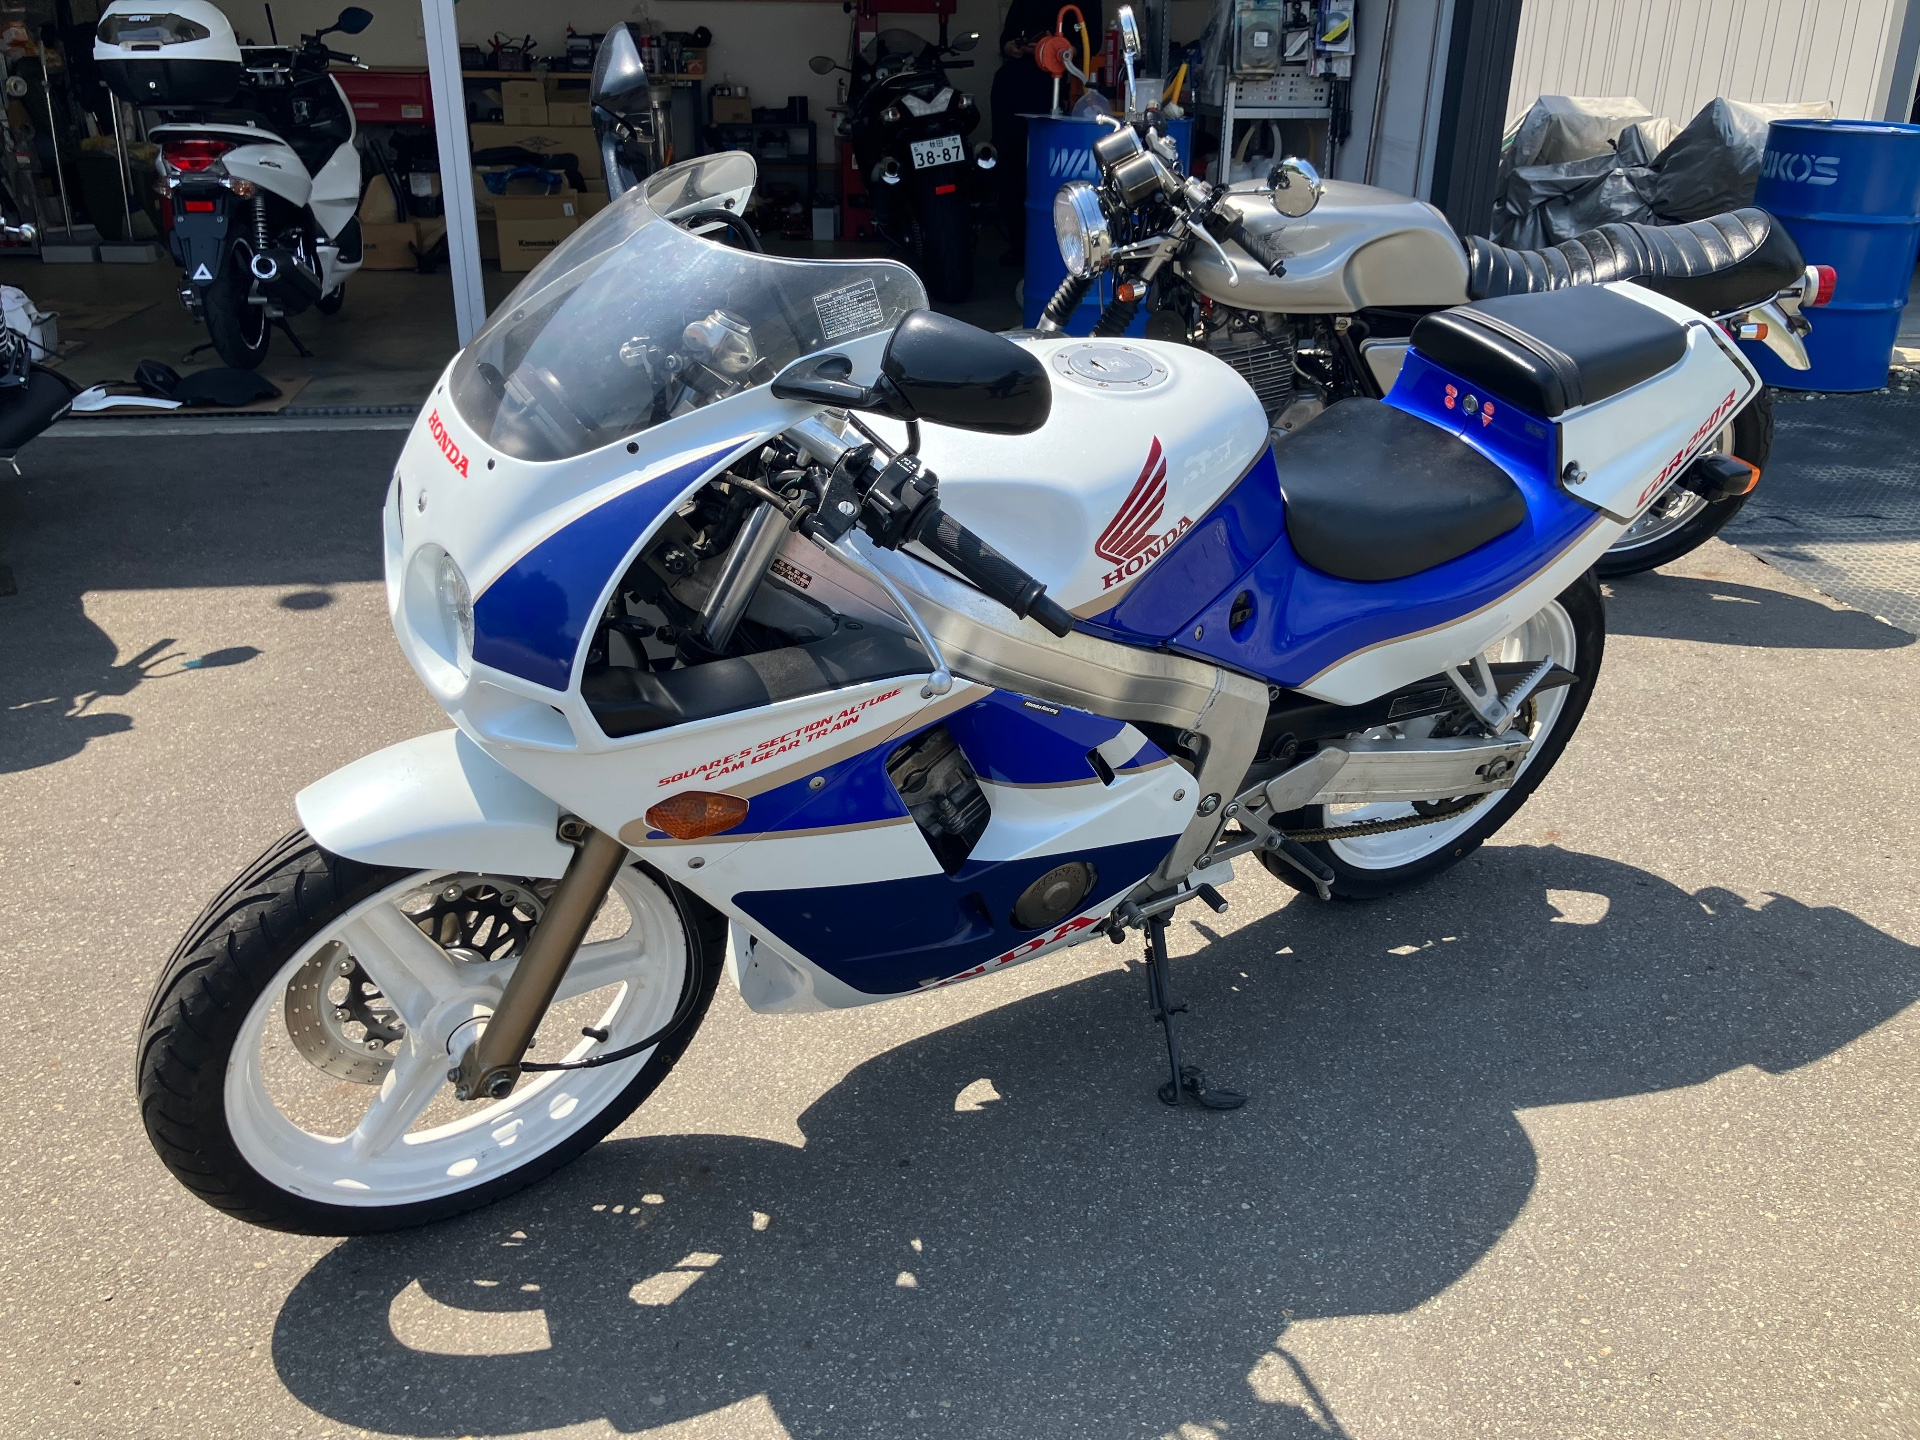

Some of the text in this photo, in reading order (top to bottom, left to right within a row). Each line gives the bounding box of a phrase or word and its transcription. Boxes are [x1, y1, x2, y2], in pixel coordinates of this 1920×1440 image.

[915, 145, 961, 167] 38-87
[1049, 147, 1103, 179] WA
[1760, 149, 1841, 186] AKO'S
[428, 407, 469, 479] HONDA
[1101, 515, 1194, 591] HONDA
[704, 714, 860, 781] CAM GEAR TRAIN
[755, 715, 834, 753] SECTION
